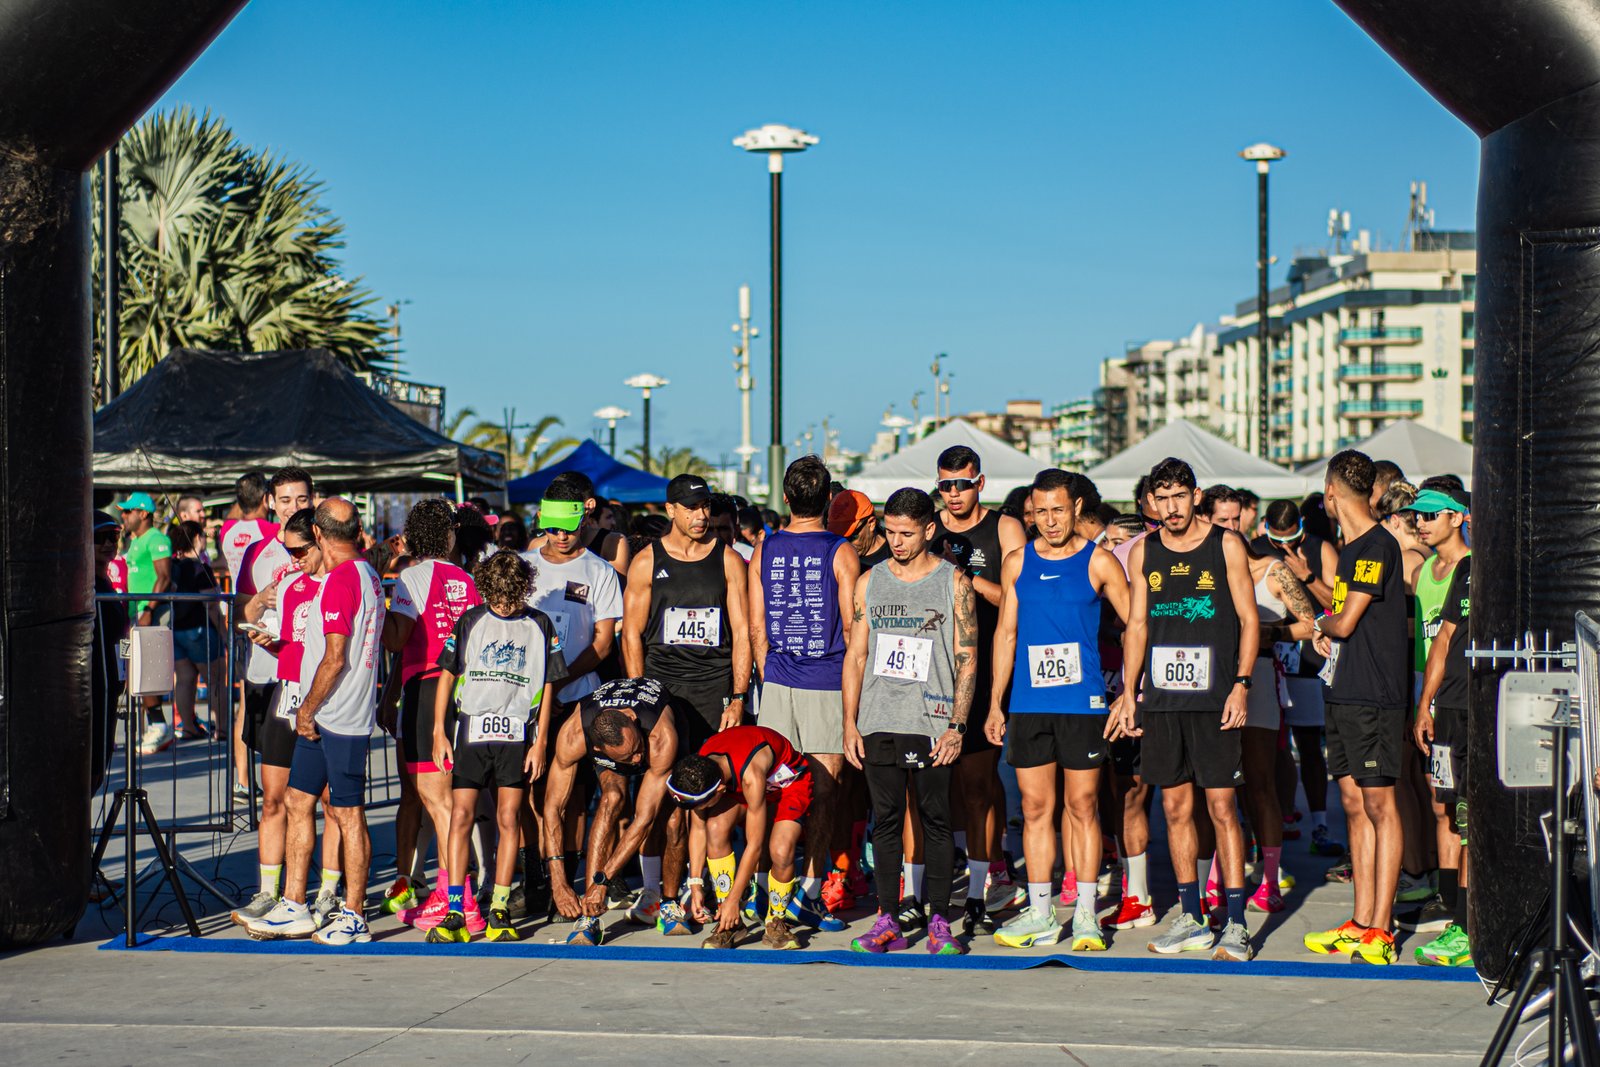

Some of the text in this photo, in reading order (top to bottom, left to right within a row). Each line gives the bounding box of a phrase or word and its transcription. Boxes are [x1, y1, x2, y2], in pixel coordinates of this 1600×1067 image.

[869, 604, 908, 618] EQUIPE
[677, 621, 706, 639] 445
[871, 617, 925, 630] MOVIMENT
[886, 650, 916, 670] 49
[1037, 659, 1066, 679] 426
[1165, 662, 1195, 682] 603
[482, 716, 511, 734] 669
